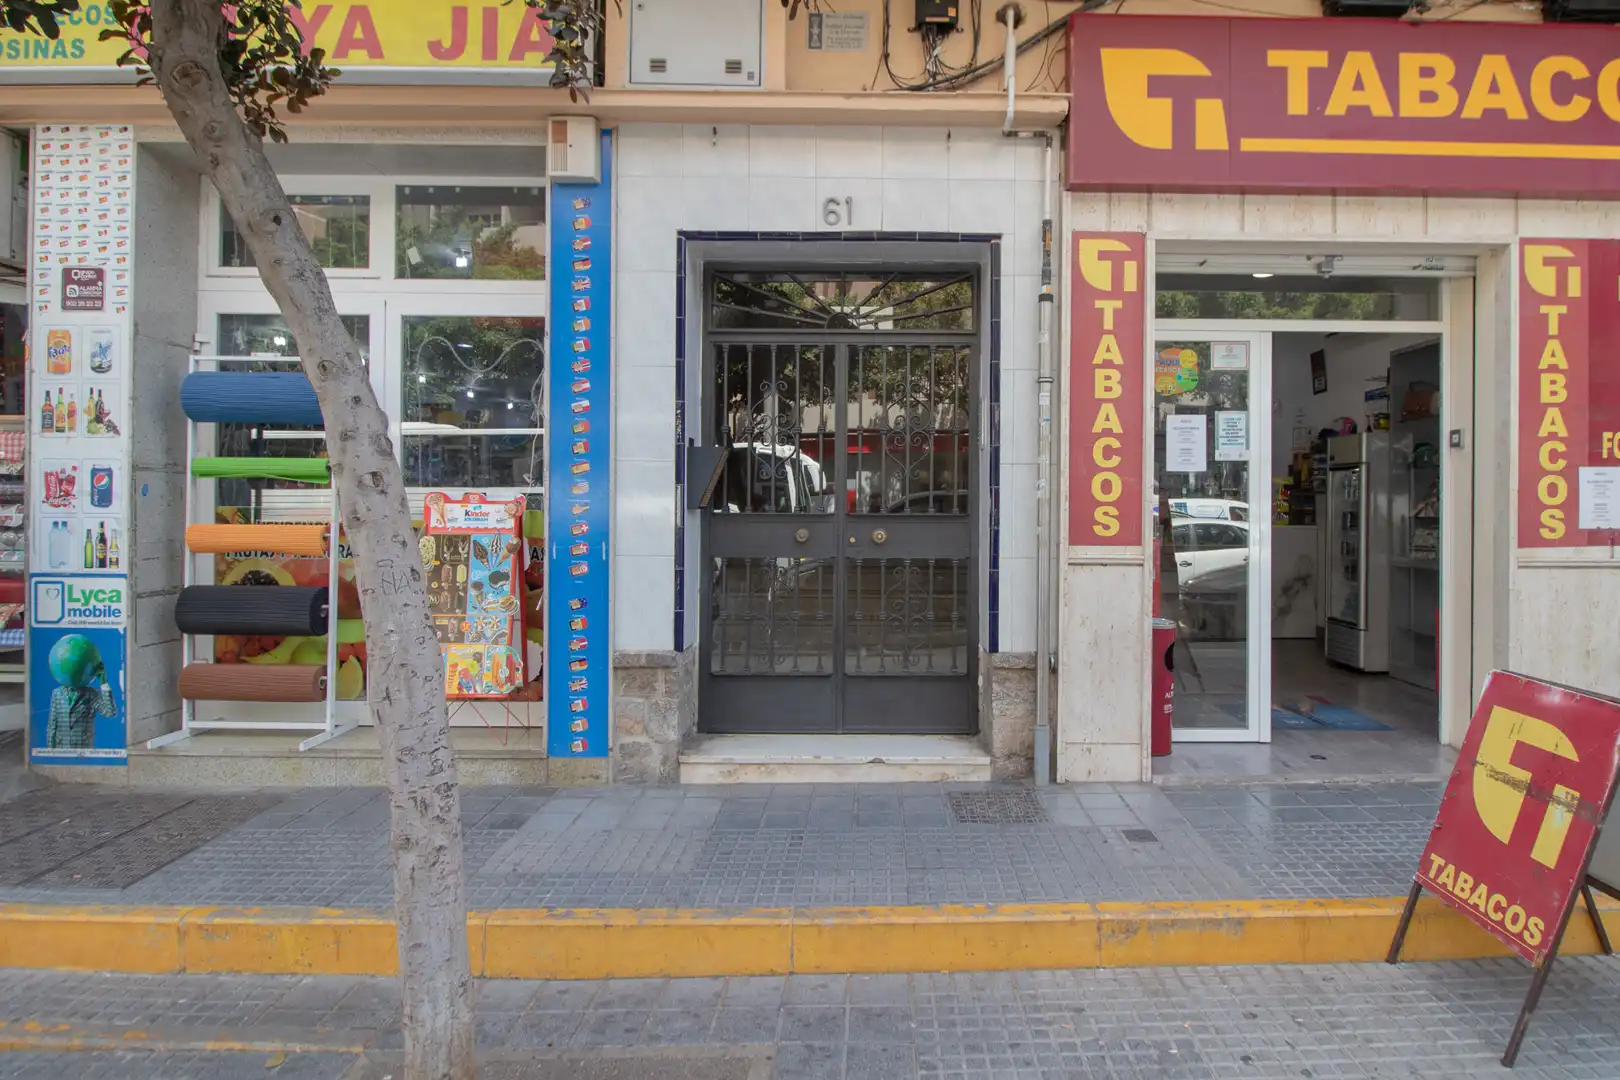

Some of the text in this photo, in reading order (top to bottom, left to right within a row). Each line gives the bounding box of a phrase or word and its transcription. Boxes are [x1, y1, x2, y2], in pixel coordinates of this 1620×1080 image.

[0, 38, 85, 60] SINAS
[427, 5, 556, 62] JIA
[822, 196, 852, 226] 61
[1091, 299, 1124, 538] TABACOS
[1537, 304, 1569, 540] TABACOS
[67, 583, 121, 607] Lyca
[67, 605, 121, 618] mobile
[1429, 852, 1546, 947] TABACOS
